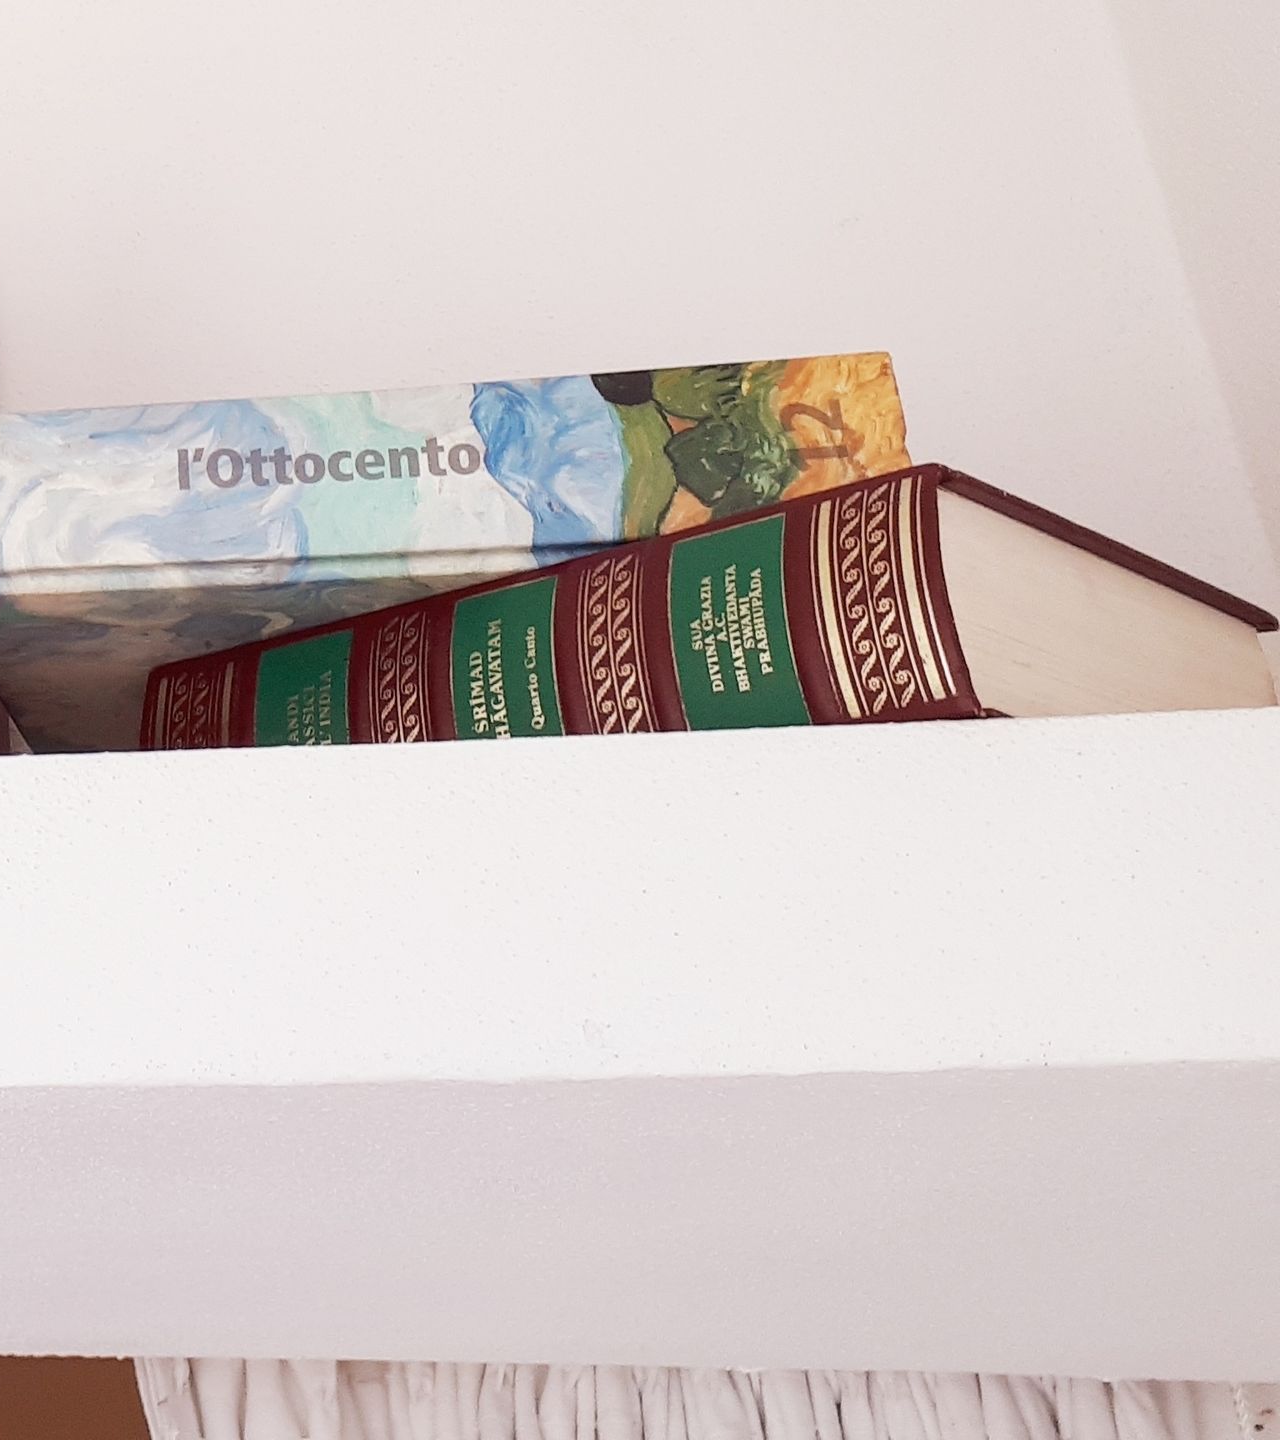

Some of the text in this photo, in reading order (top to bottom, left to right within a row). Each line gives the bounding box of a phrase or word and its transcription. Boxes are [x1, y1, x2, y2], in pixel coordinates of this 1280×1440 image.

[177, 436, 481, 490] l'Ottocento
[779, 398, 849, 472] 12
[690, 619, 703, 651] SUA
[700, 575, 724, 693] DIVINA GRAZIA
[714, 612, 728, 642] A.C.
[725, 563, 750, 693] BHAKTIVEDANTA
[739, 596, 755, 650] SWAMI
[524, 626, 545, 730] Quarto Canto
